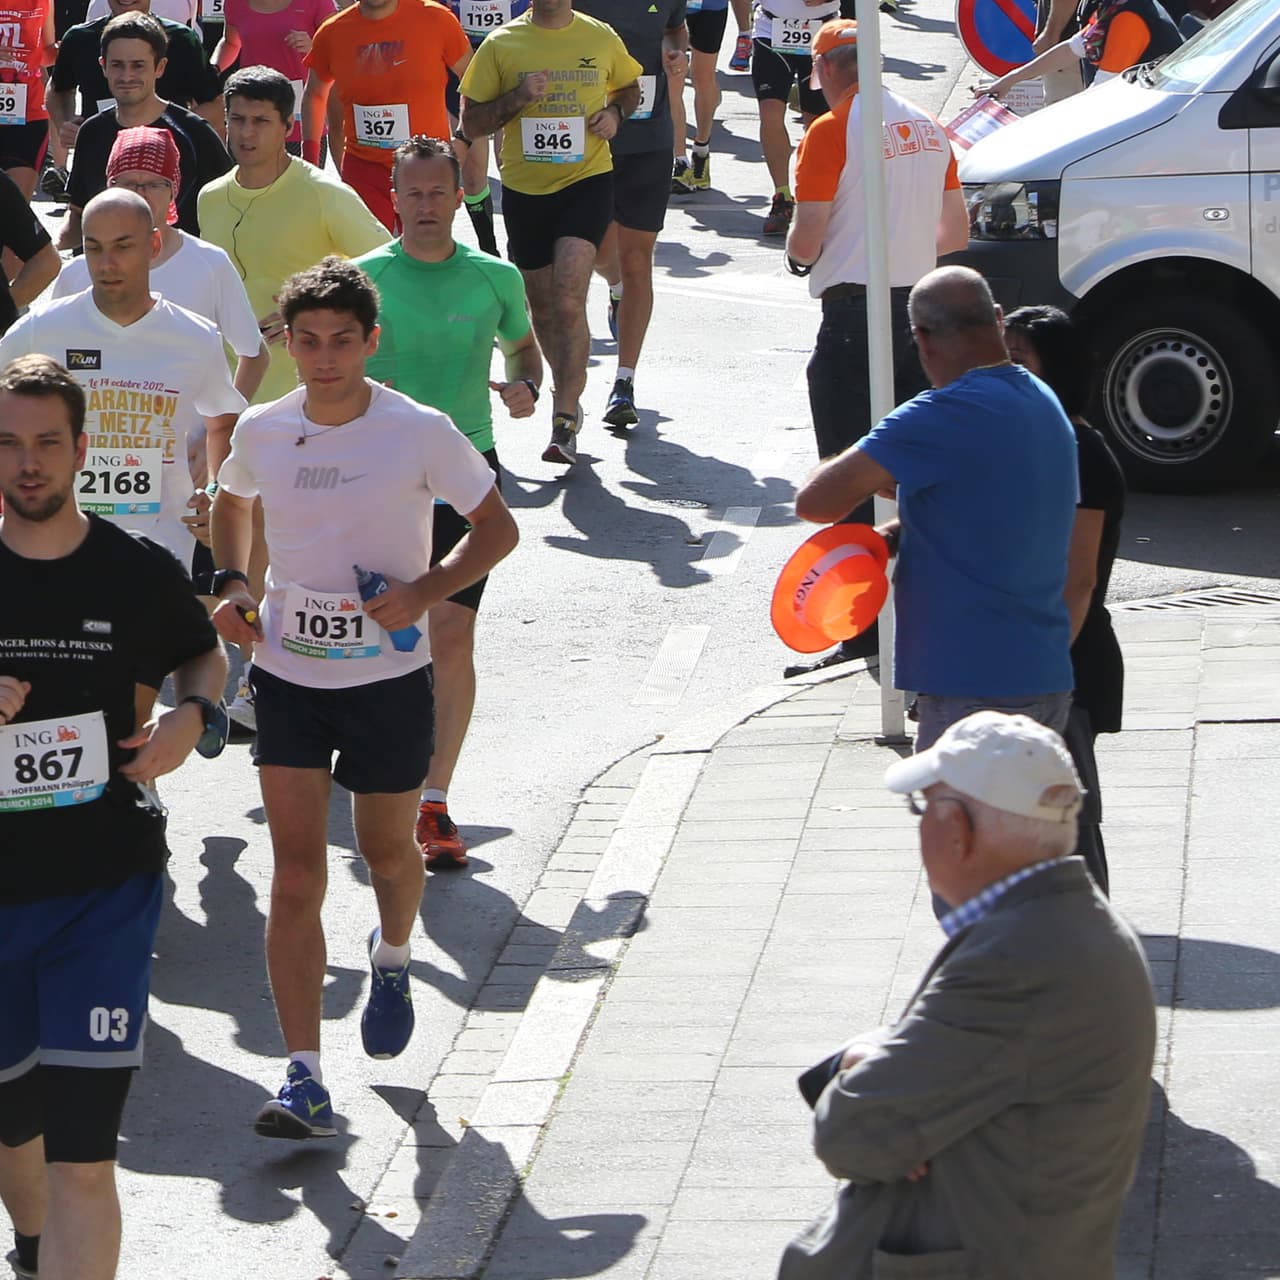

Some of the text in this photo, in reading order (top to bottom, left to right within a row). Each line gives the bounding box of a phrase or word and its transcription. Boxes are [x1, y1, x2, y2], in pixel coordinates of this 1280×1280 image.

[467, 12, 504, 27] 1193
[781, 31, 812, 44] 299
[363, 120, 395, 136] 367
[535, 122, 556, 131] ING
[533, 133, 572, 150] 846
[143, 381, 164, 392] 2012
[88, 389, 178, 417] ARATHON
[100, 411, 153, 435] METZ
[92, 456, 121, 467] ING
[79, 470, 151, 495] 2168
[294, 467, 339, 489] RUN
[304, 597, 335, 612] ING
[295, 611, 363, 640] 1031
[30, 639, 57, 648] HOSS
[58, 639, 67, 648] &
[69, 641, 113, 651] PRUSSEN
[295, 635, 315, 645] HANS
[316, 639, 333, 647] PAUL
[308, 647, 326, 656] 2014
[14, 730, 52, 748] ING
[13, 745, 84, 785] 867
[11, 778, 95, 796] HOFFMANN Philippe
[32, 796, 52, 807] 2014
[88, 1006, 128, 1043] 03
